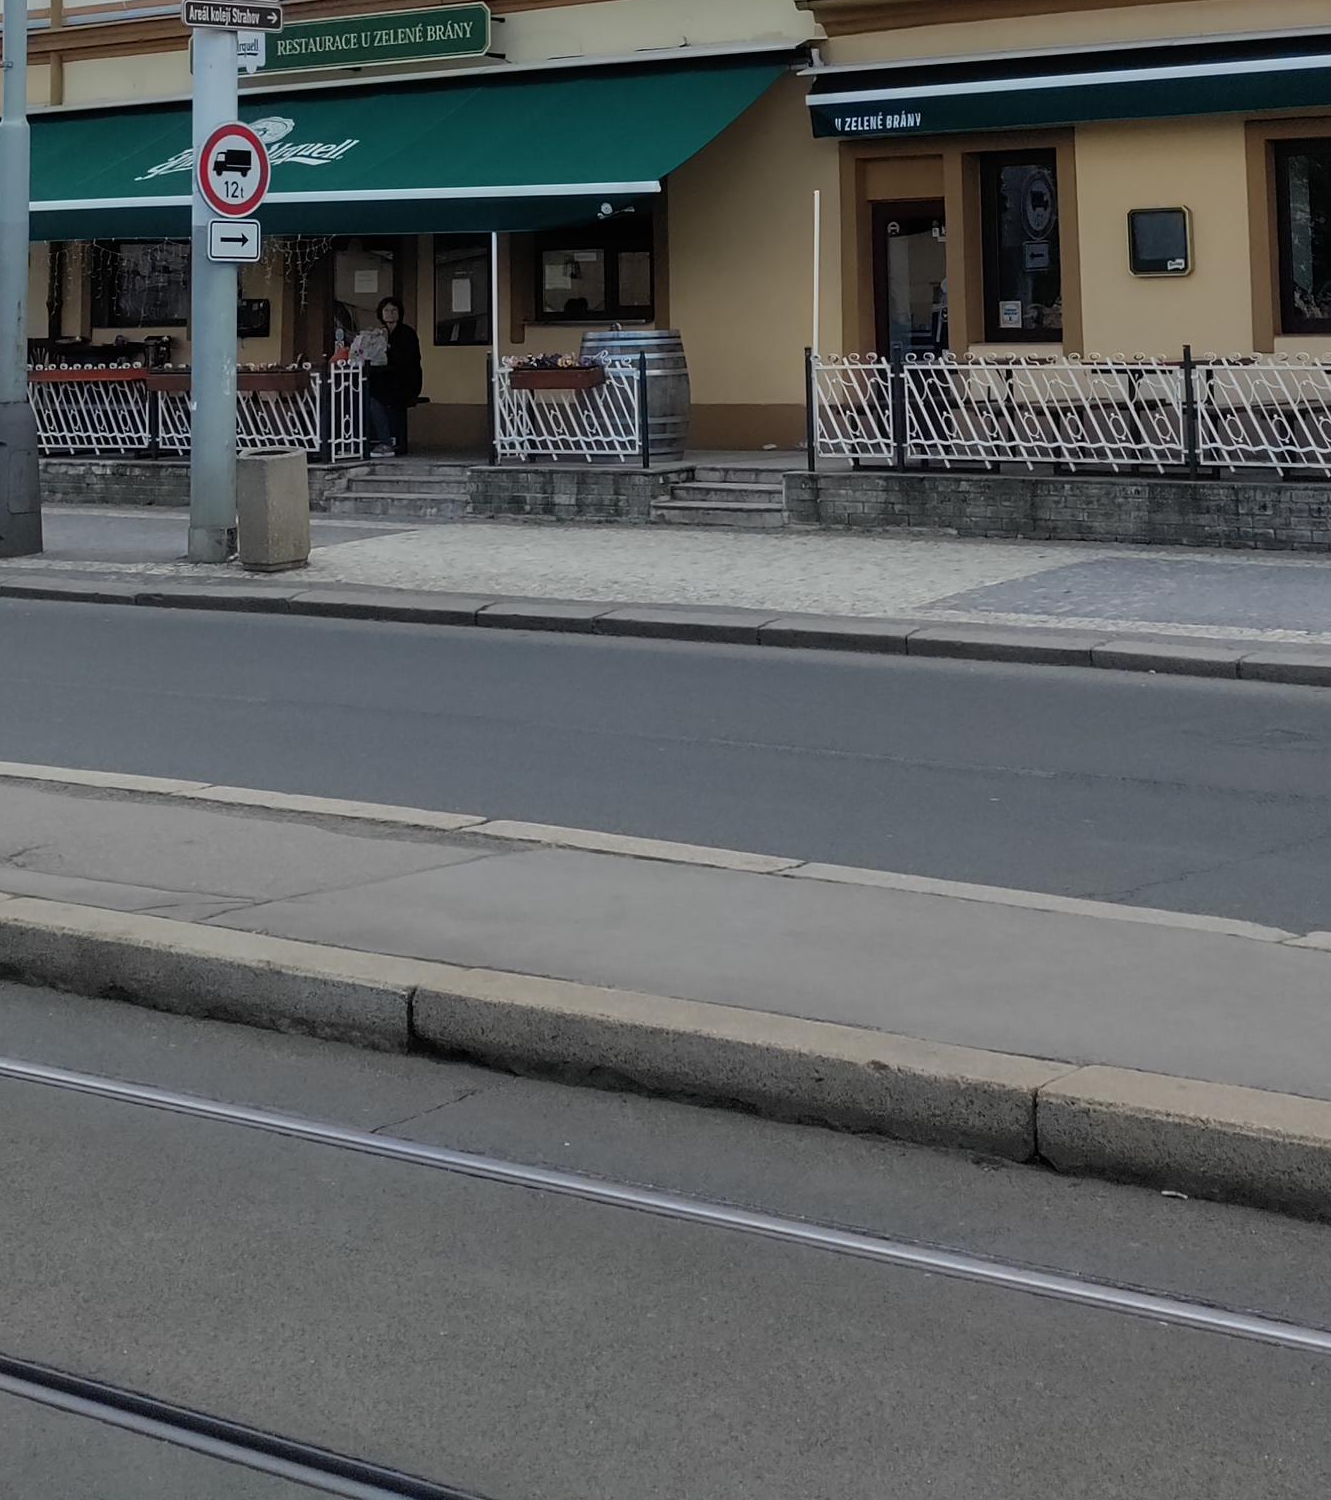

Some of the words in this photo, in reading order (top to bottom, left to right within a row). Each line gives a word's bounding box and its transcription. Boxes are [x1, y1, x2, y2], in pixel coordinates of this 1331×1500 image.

[189, 5, 209, 22] Areál
[210, 6, 232, 26] kolejí
[232, 7, 260, 25] Strahov
[276, 33, 358, 56] RESTAURACE
[361, 31, 371, 47] U
[373, 24, 424, 46] ZELENÉ
[426, 20, 473, 41] BRÁNY
[834, 118, 842, 131] U
[844, 111, 884, 131] ZELENÉ
[886, 110, 921, 129] BRÁNY
